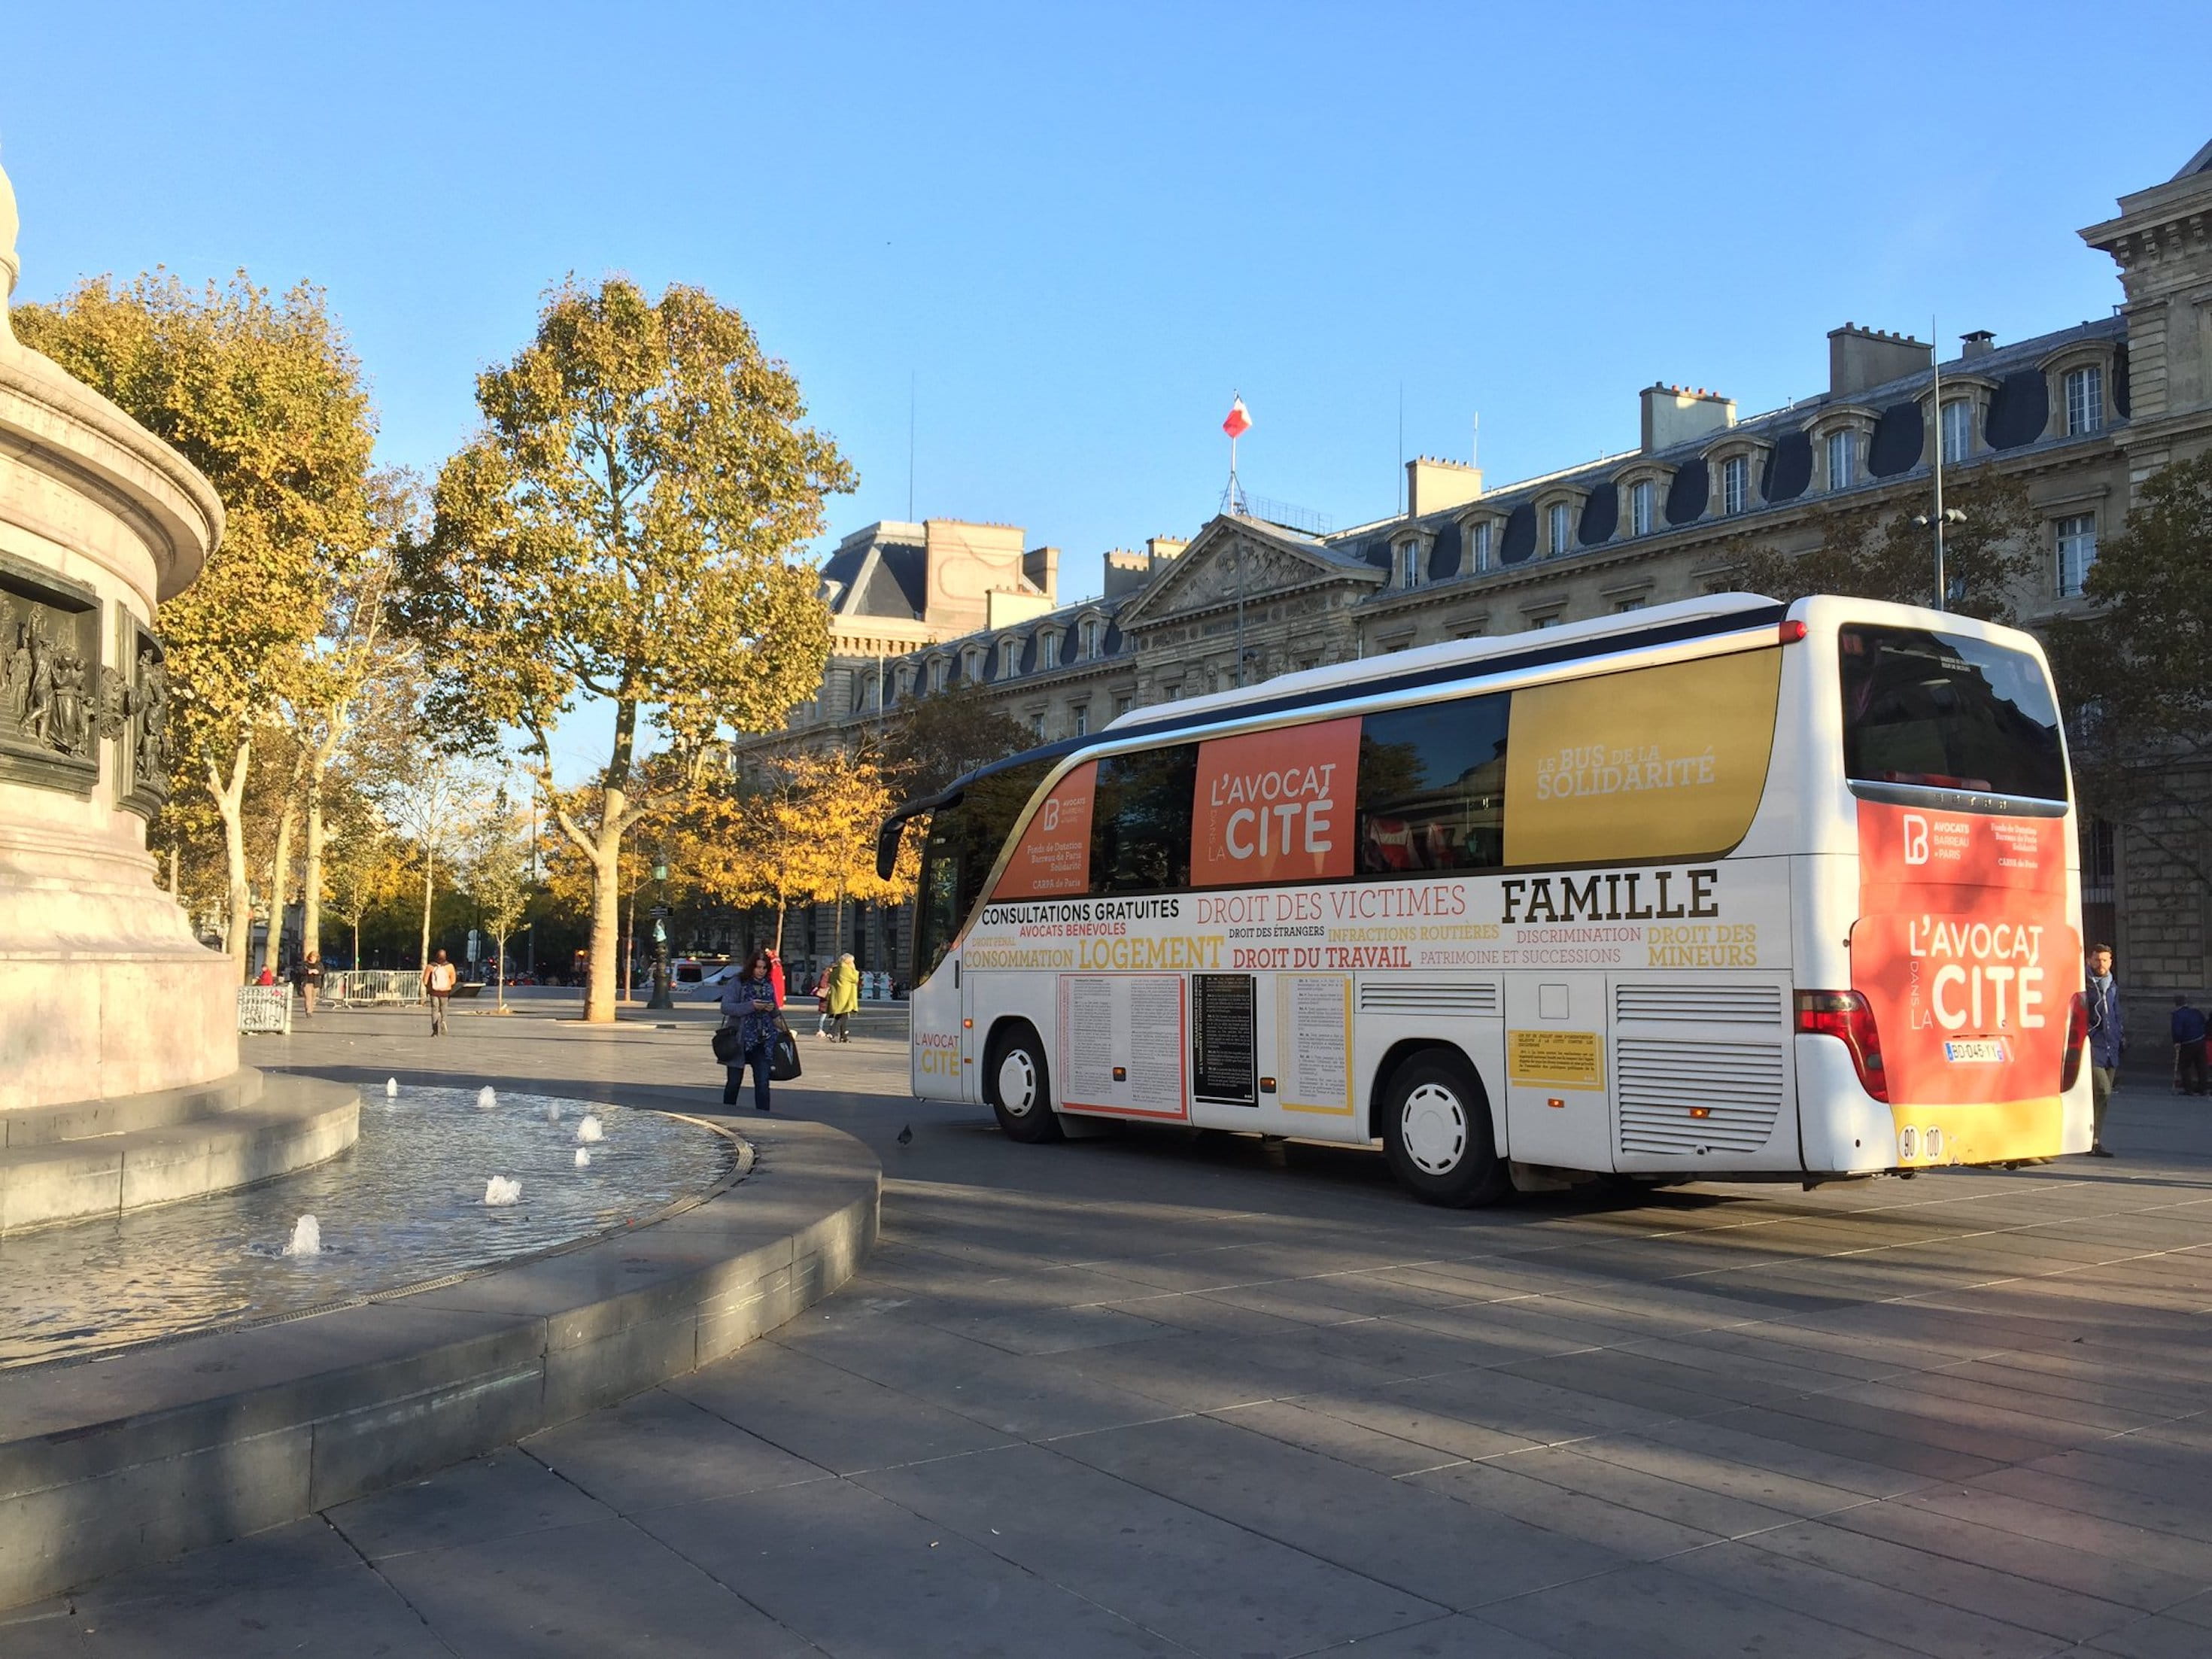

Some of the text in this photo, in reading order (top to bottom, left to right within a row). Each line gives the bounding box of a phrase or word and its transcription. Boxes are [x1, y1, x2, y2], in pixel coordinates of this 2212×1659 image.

[1538, 744, 1661, 773] LE BUS DE LA
[1211, 763, 1336, 807] L'AVOCAT
[1536, 746, 1716, 801] SOLIDARITÉ
[1226, 785, 1333, 859] CITÉ
[1934, 822, 1970, 834] AVOCATS
[1208, 846, 1226, 861] LA
[1197, 885, 1466, 924] DROIT DES VICTIMES
[1501, 868, 1718, 924] FAMILLE
[982, 899, 1179, 925] CONSULTATIONS GRATUITES
[1019, 920, 1126, 937] AVOCATS BÉNÉVOLES
[1229, 924, 1325, 938] DROIT DES ÉTRANGERS
[1328, 921, 1499, 942] INFRACTIONS ROUTIÈRES
[1517, 927, 1642, 944] DISCRIMINATION
[1647, 924, 1757, 944] DROIT DES
[1910, 914, 2043, 959] L'AVOCAT
[965, 950, 1074, 968] CONSOMMATION
[1079, 935, 1225, 969] LOGEMENT
[1233, 946, 1411, 968] DROIT DU TRAVAIL
[1420, 949, 1621, 964] PATRIMOINE ET SUCCESSIONS
[1648, 945, 1758, 967] MINEURS
[1910, 961, 1919, 1007] DANS
[1932, 953, 2045, 1030] CITÉ
[1911, 1009, 1934, 1030] LA
[1904, 1129, 1915, 1157] 90
[1926, 1129, 1939, 1156] 100
